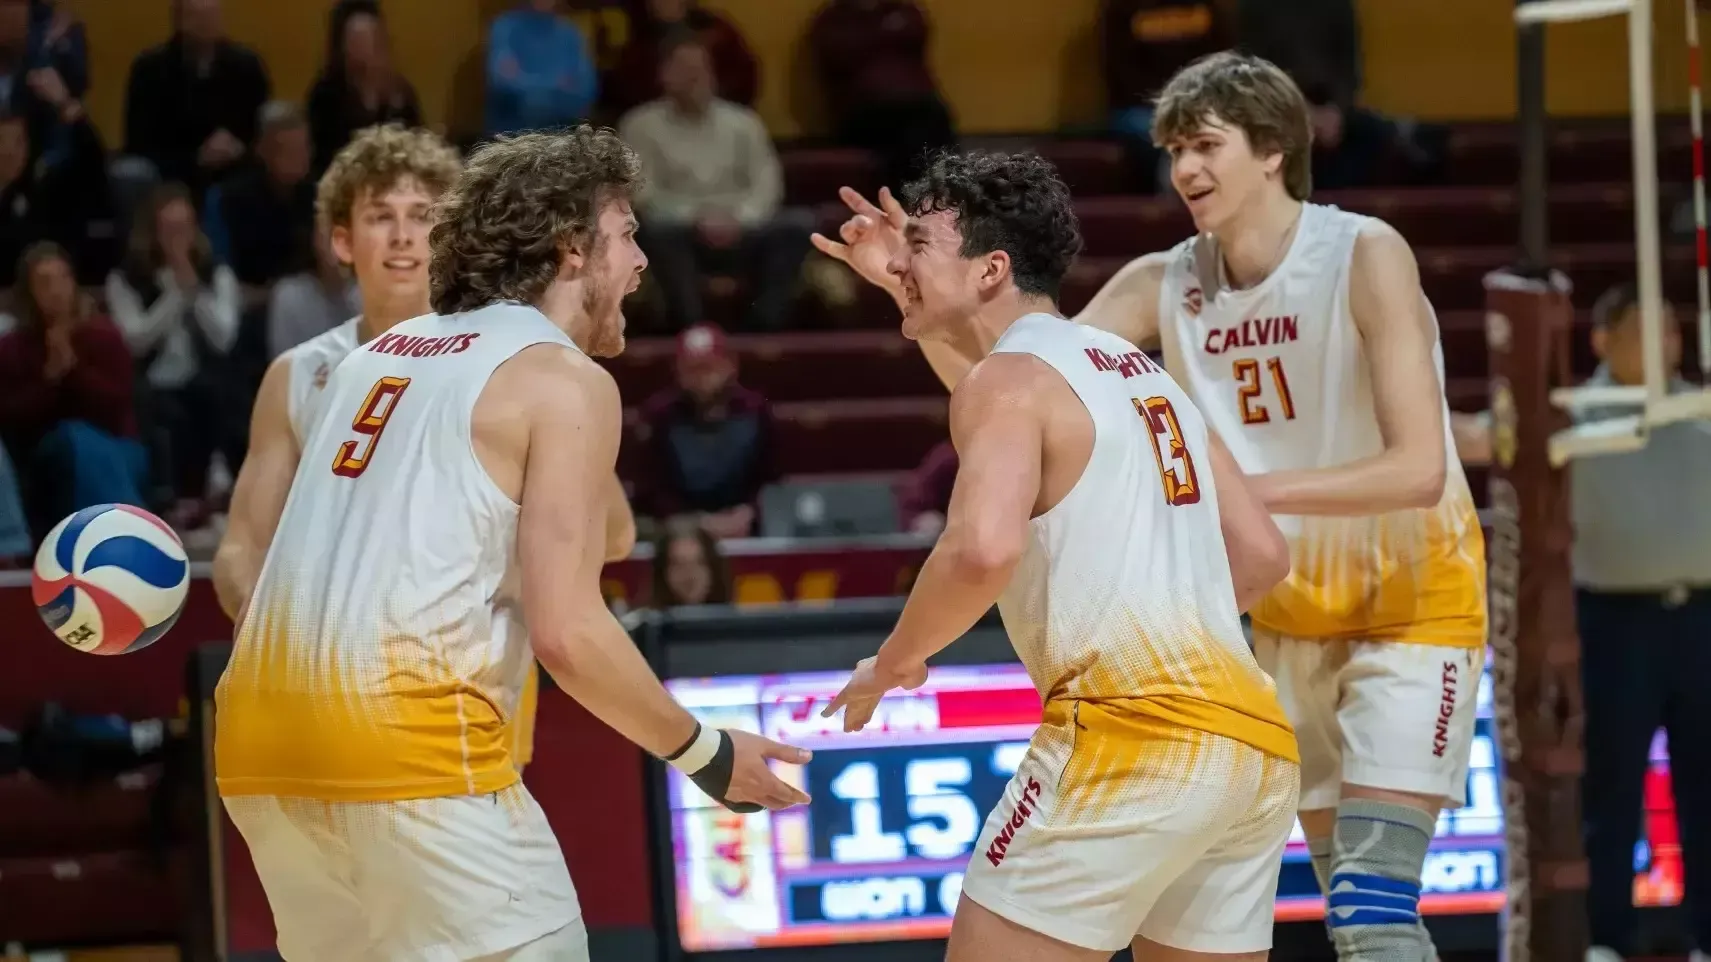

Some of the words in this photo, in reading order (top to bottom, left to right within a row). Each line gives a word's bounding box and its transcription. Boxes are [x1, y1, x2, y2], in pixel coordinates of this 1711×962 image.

[368, 332, 481, 357] KNIGHTS
[1204, 315, 1299, 354] CALVIN
[332, 376, 411, 478] 9
[1232, 356, 1296, 424] 21
[1131, 396, 1201, 506] 13
[1432, 661, 1458, 758] KNIGHTS
[829, 757, 980, 865] 15
[985, 775, 1041, 868] KNIGHTS
